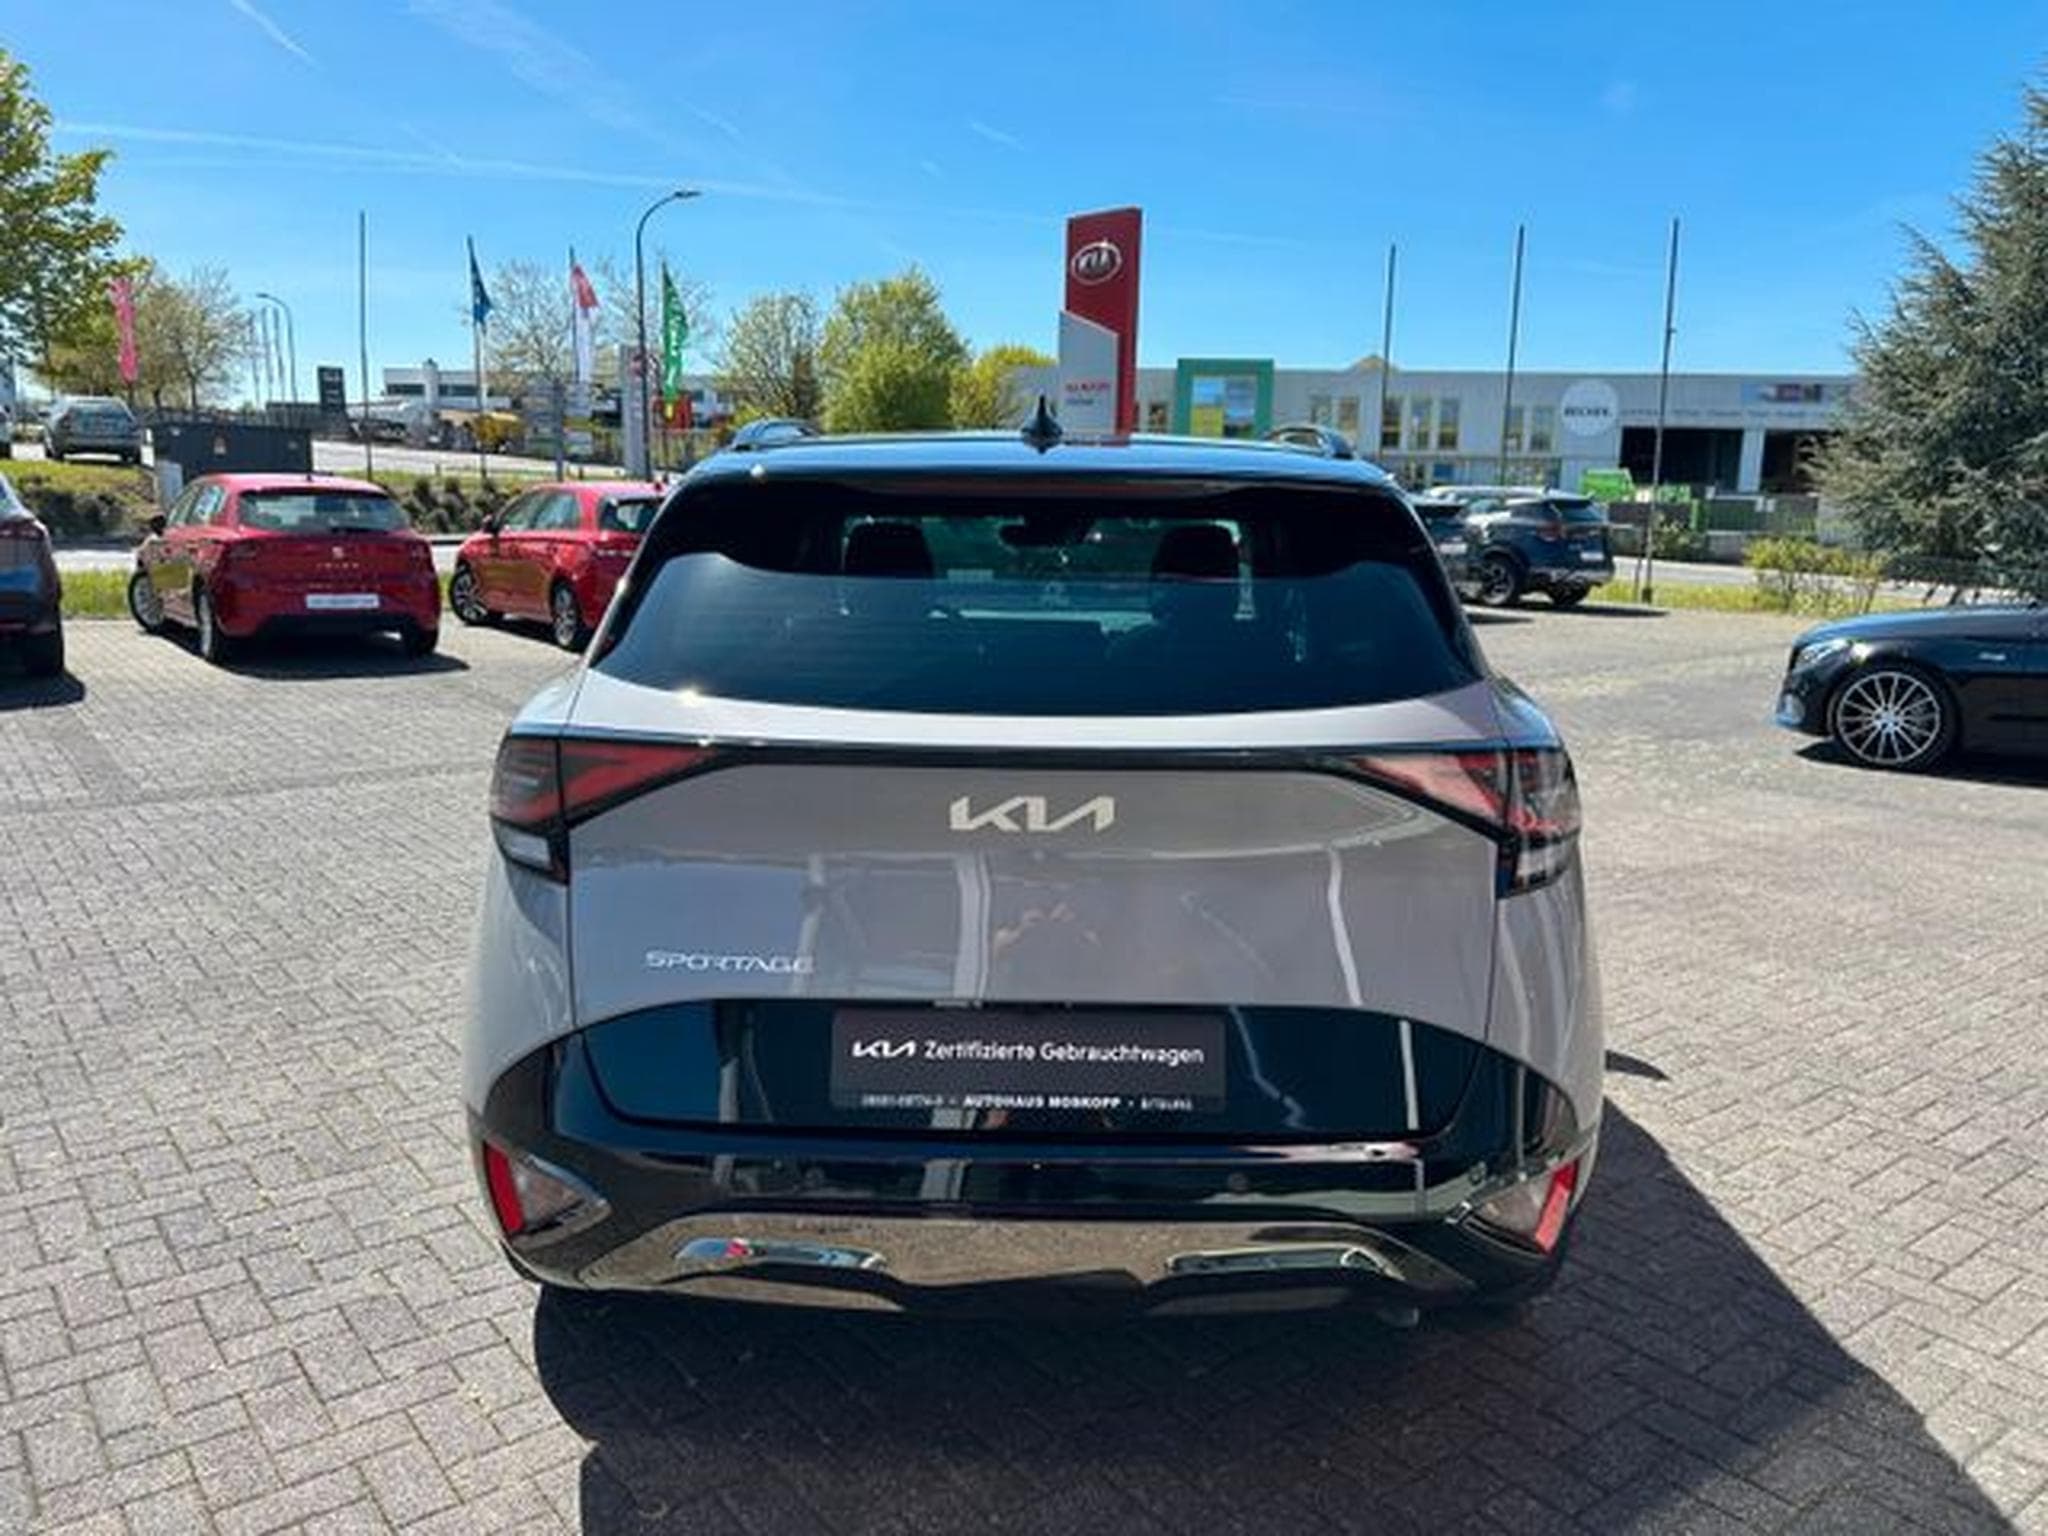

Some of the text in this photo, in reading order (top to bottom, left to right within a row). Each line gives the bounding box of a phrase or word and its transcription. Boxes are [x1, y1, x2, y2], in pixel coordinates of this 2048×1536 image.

[949, 796, 1115, 832] KIA
[646, 951, 814, 975] SPORTAGE
[852, 1039, 1204, 1067] KIA Zertifizierte Gebrauchtwagen
[963, 1093, 1044, 1109] AUTOHAUS
